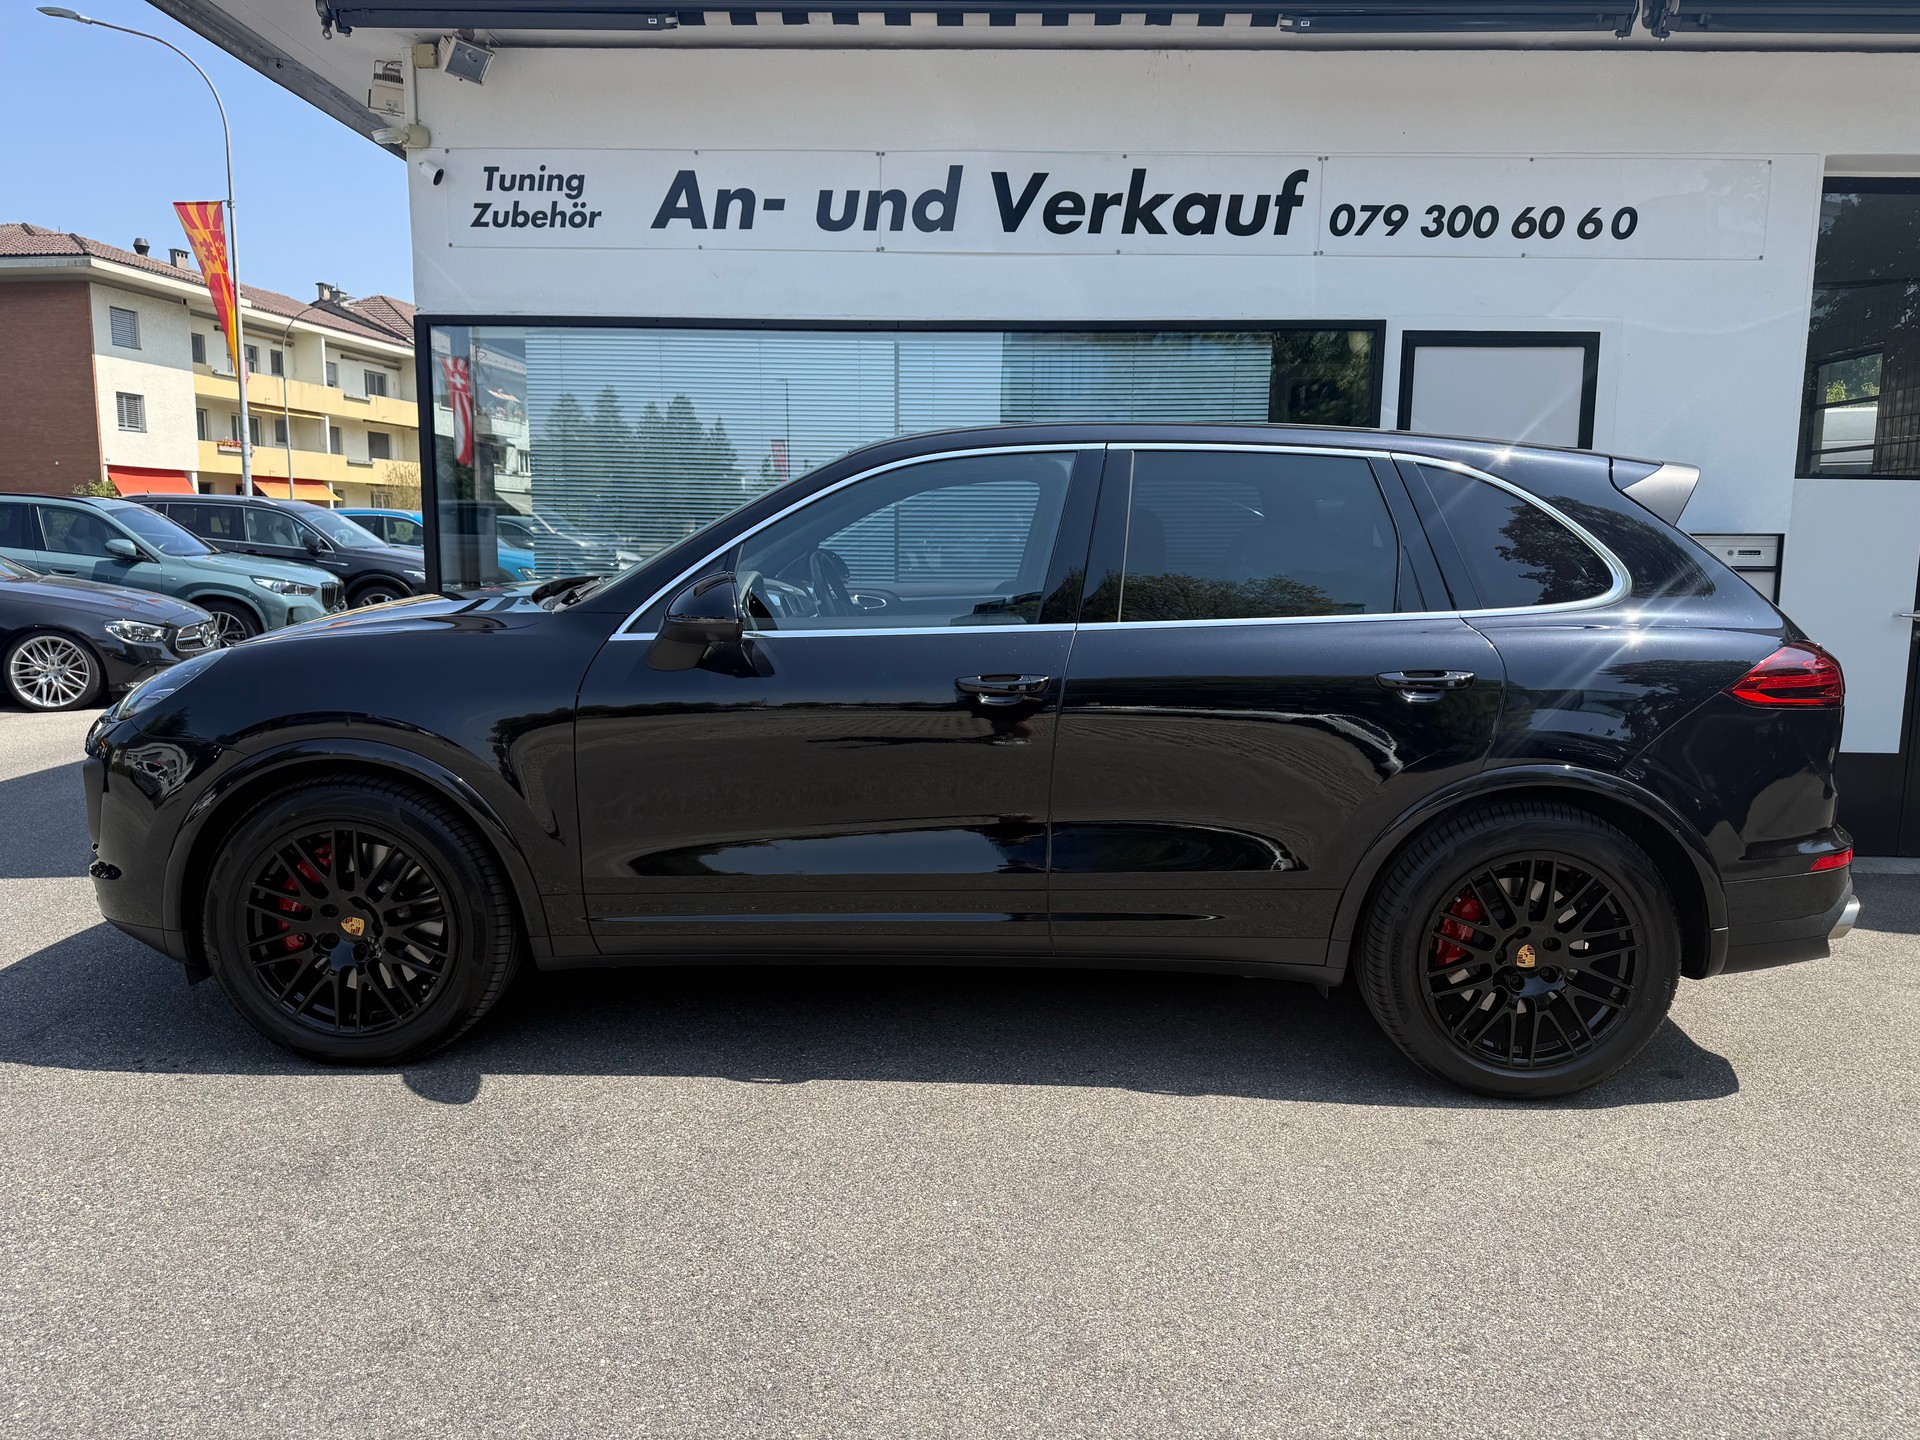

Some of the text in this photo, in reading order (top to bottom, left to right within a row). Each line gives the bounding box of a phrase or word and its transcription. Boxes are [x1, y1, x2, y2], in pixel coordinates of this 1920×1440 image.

[483, 164, 586, 200] Tuning
[649, 164, 1310, 237] An- und Verkauf
[469, 200, 603, 229] Zubehör
[1329, 203, 1639, 241] 079 300 60 60
